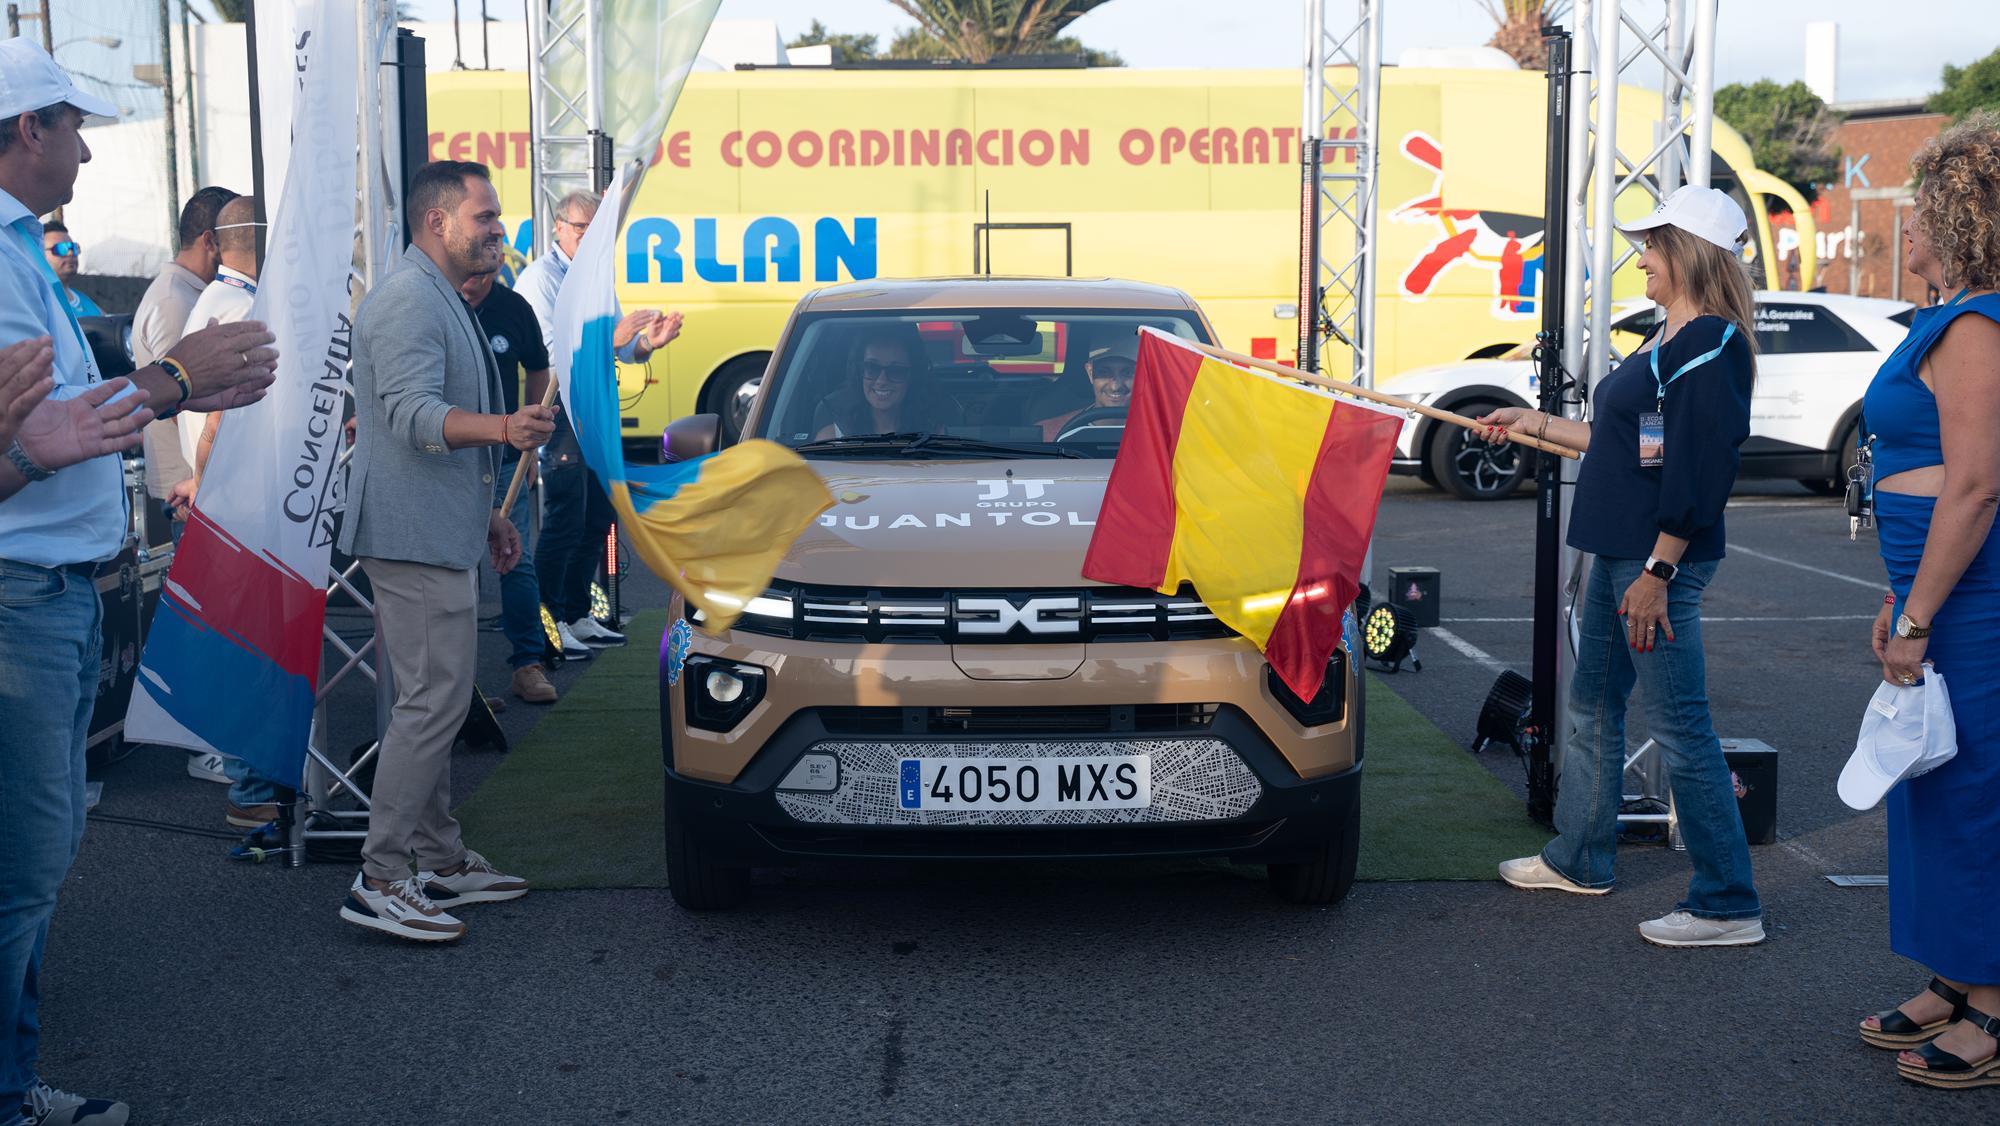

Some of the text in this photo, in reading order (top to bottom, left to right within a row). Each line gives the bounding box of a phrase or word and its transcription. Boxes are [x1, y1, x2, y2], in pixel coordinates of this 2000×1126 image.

[428, 131, 531, 169] CENT
[720, 128, 1090, 168] COORDINACION
[976, 479, 1055, 500] JT
[988, 511, 1097, 527] TOL
[930, 763, 1138, 803] 4050 MXS
[907, 789, 915, 800] E
